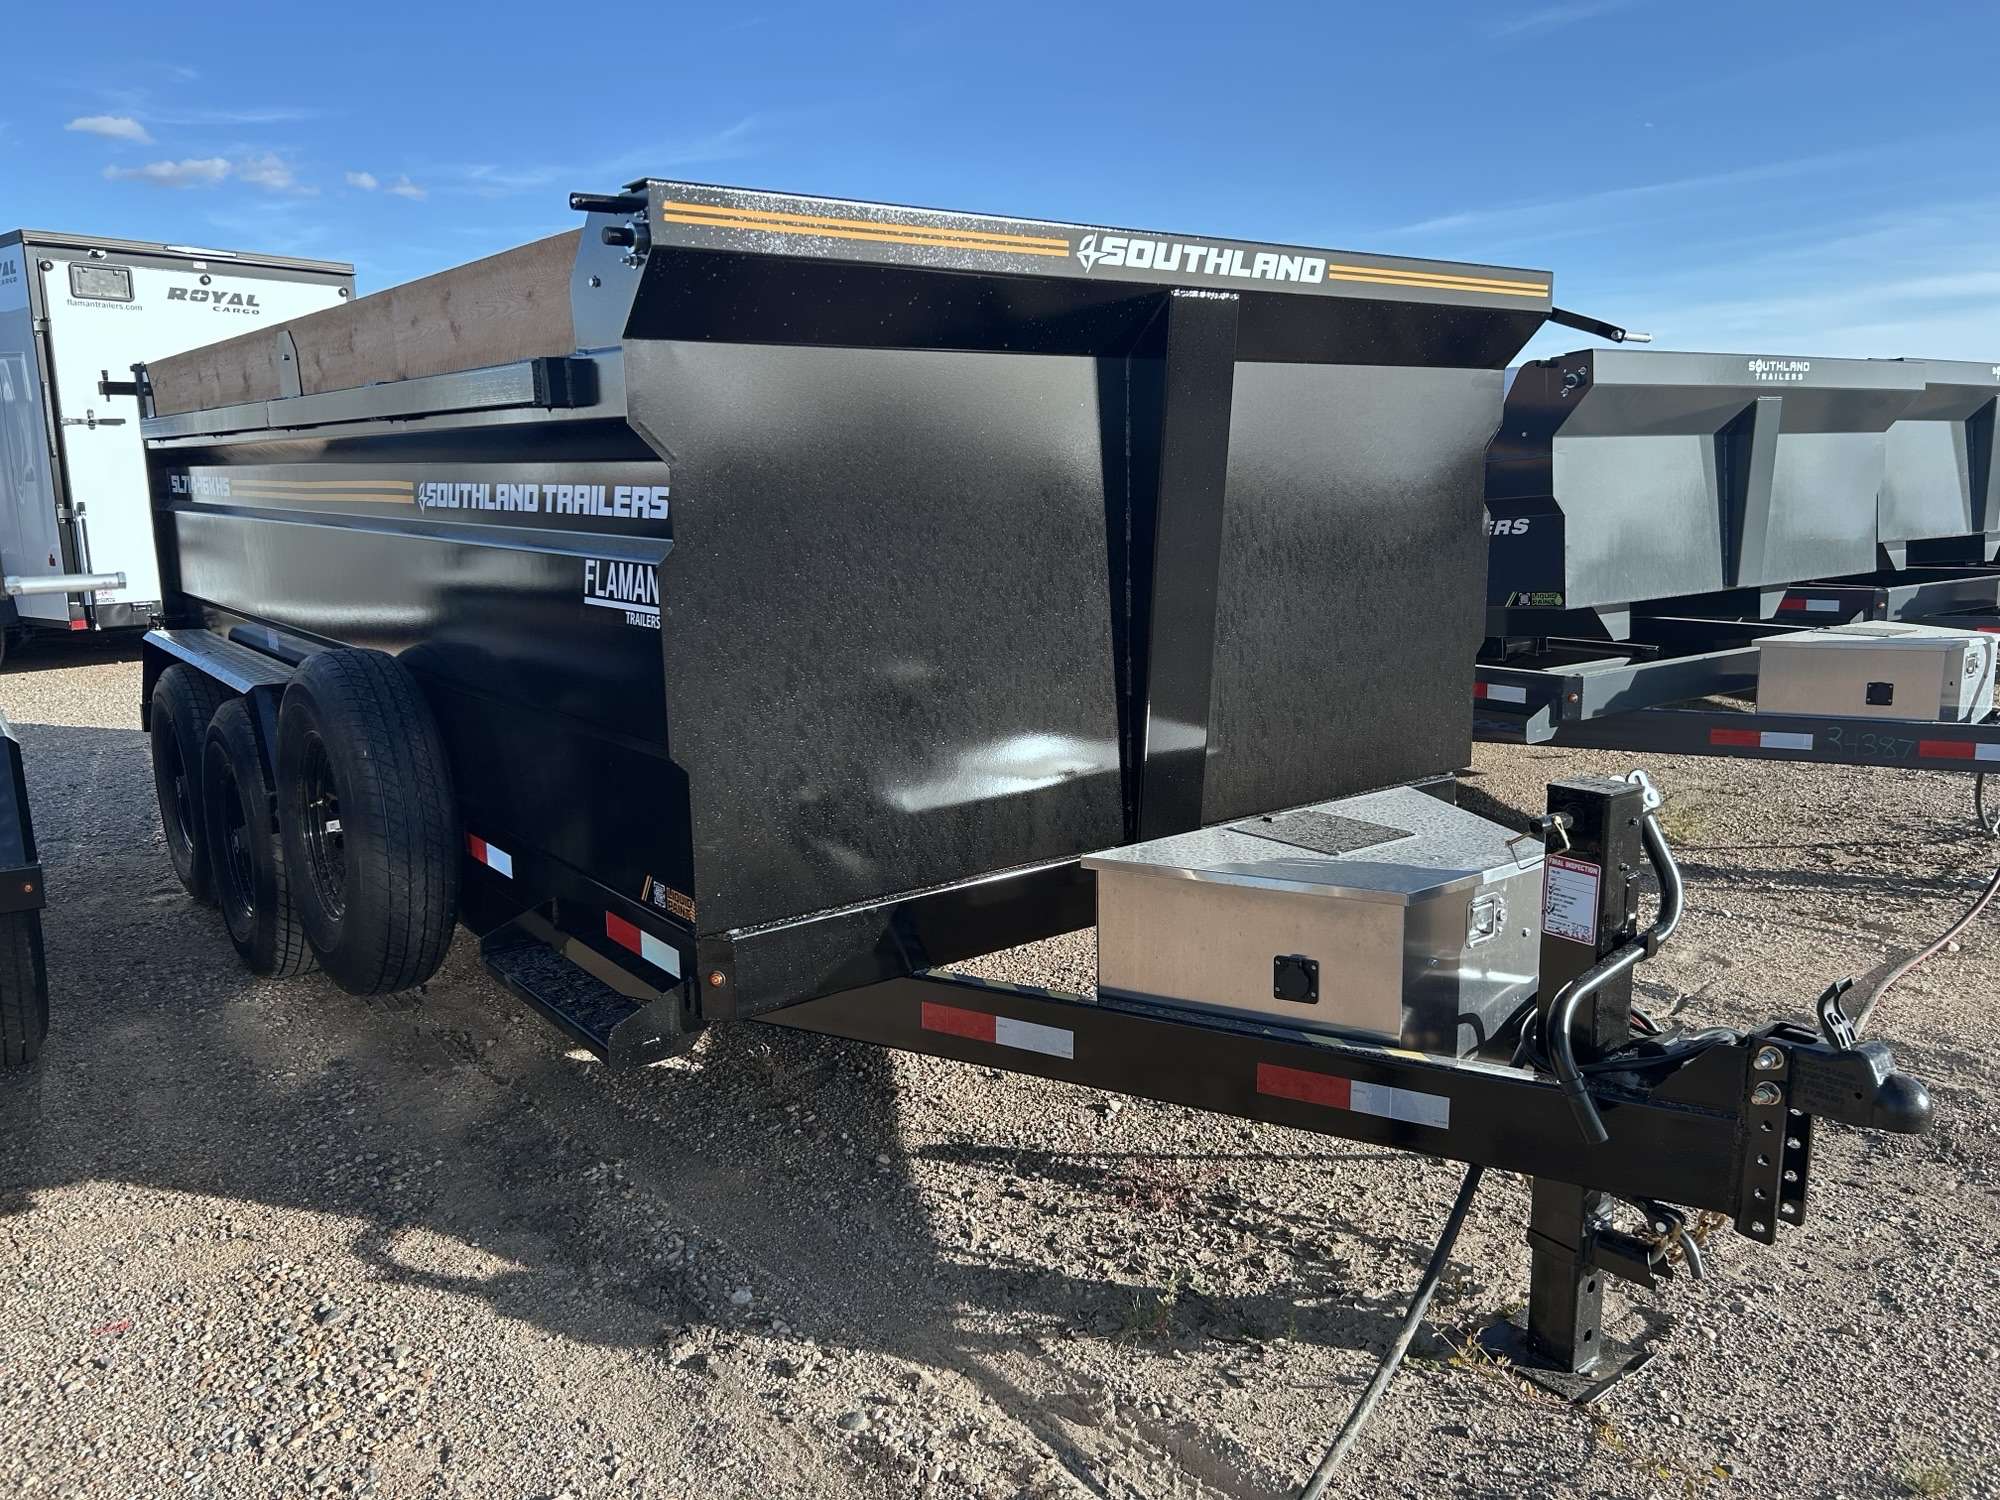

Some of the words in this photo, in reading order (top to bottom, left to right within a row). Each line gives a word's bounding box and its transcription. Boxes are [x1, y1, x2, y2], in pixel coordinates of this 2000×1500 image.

[1098, 236, 1327, 284] SOUTHLAND
[67, 298, 143, 312] flamantrailers.com
[167, 287, 260, 308] ROYAL
[213, 306, 261, 315] CARGO
[1748, 359, 1810, 373] SOUTHLAND
[1755, 372, 1804, 381] TRAILERS
[426, 482, 539, 513] SOUTHLAND
[542, 484, 670, 520] TRAILERS
[584, 559, 660, 605] FLAMAN
[625, 611, 661, 630] TRAILERS
